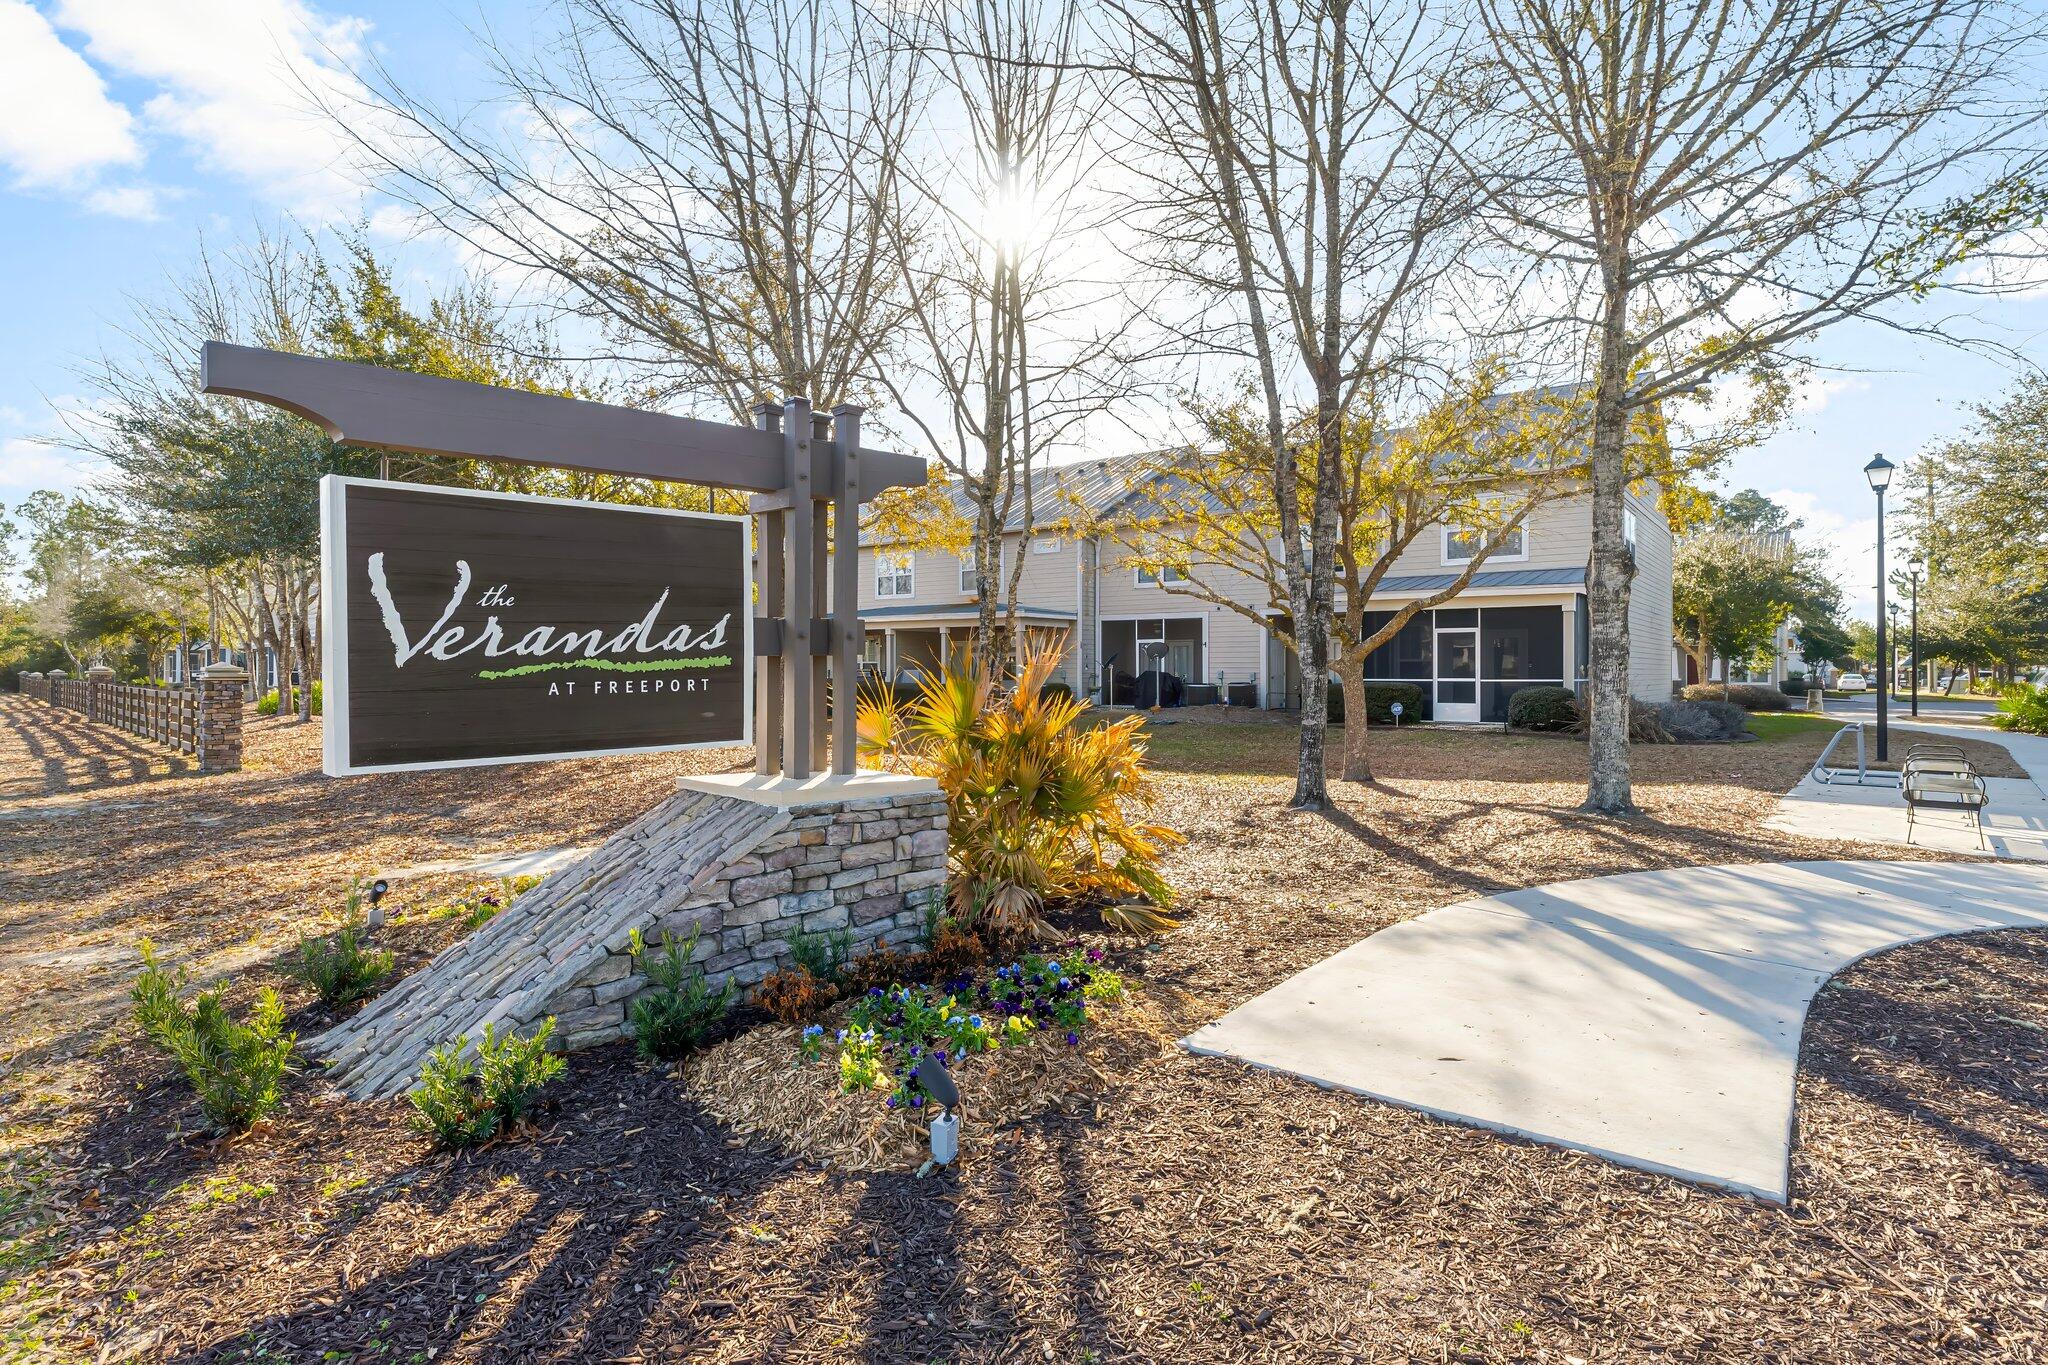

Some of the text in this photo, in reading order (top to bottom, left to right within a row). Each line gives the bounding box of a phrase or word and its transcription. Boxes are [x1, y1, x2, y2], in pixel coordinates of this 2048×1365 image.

[475, 583, 515, 607] the
[367, 551, 732, 668] Verandas
[548, 678, 709, 696] AT FREEPORT
